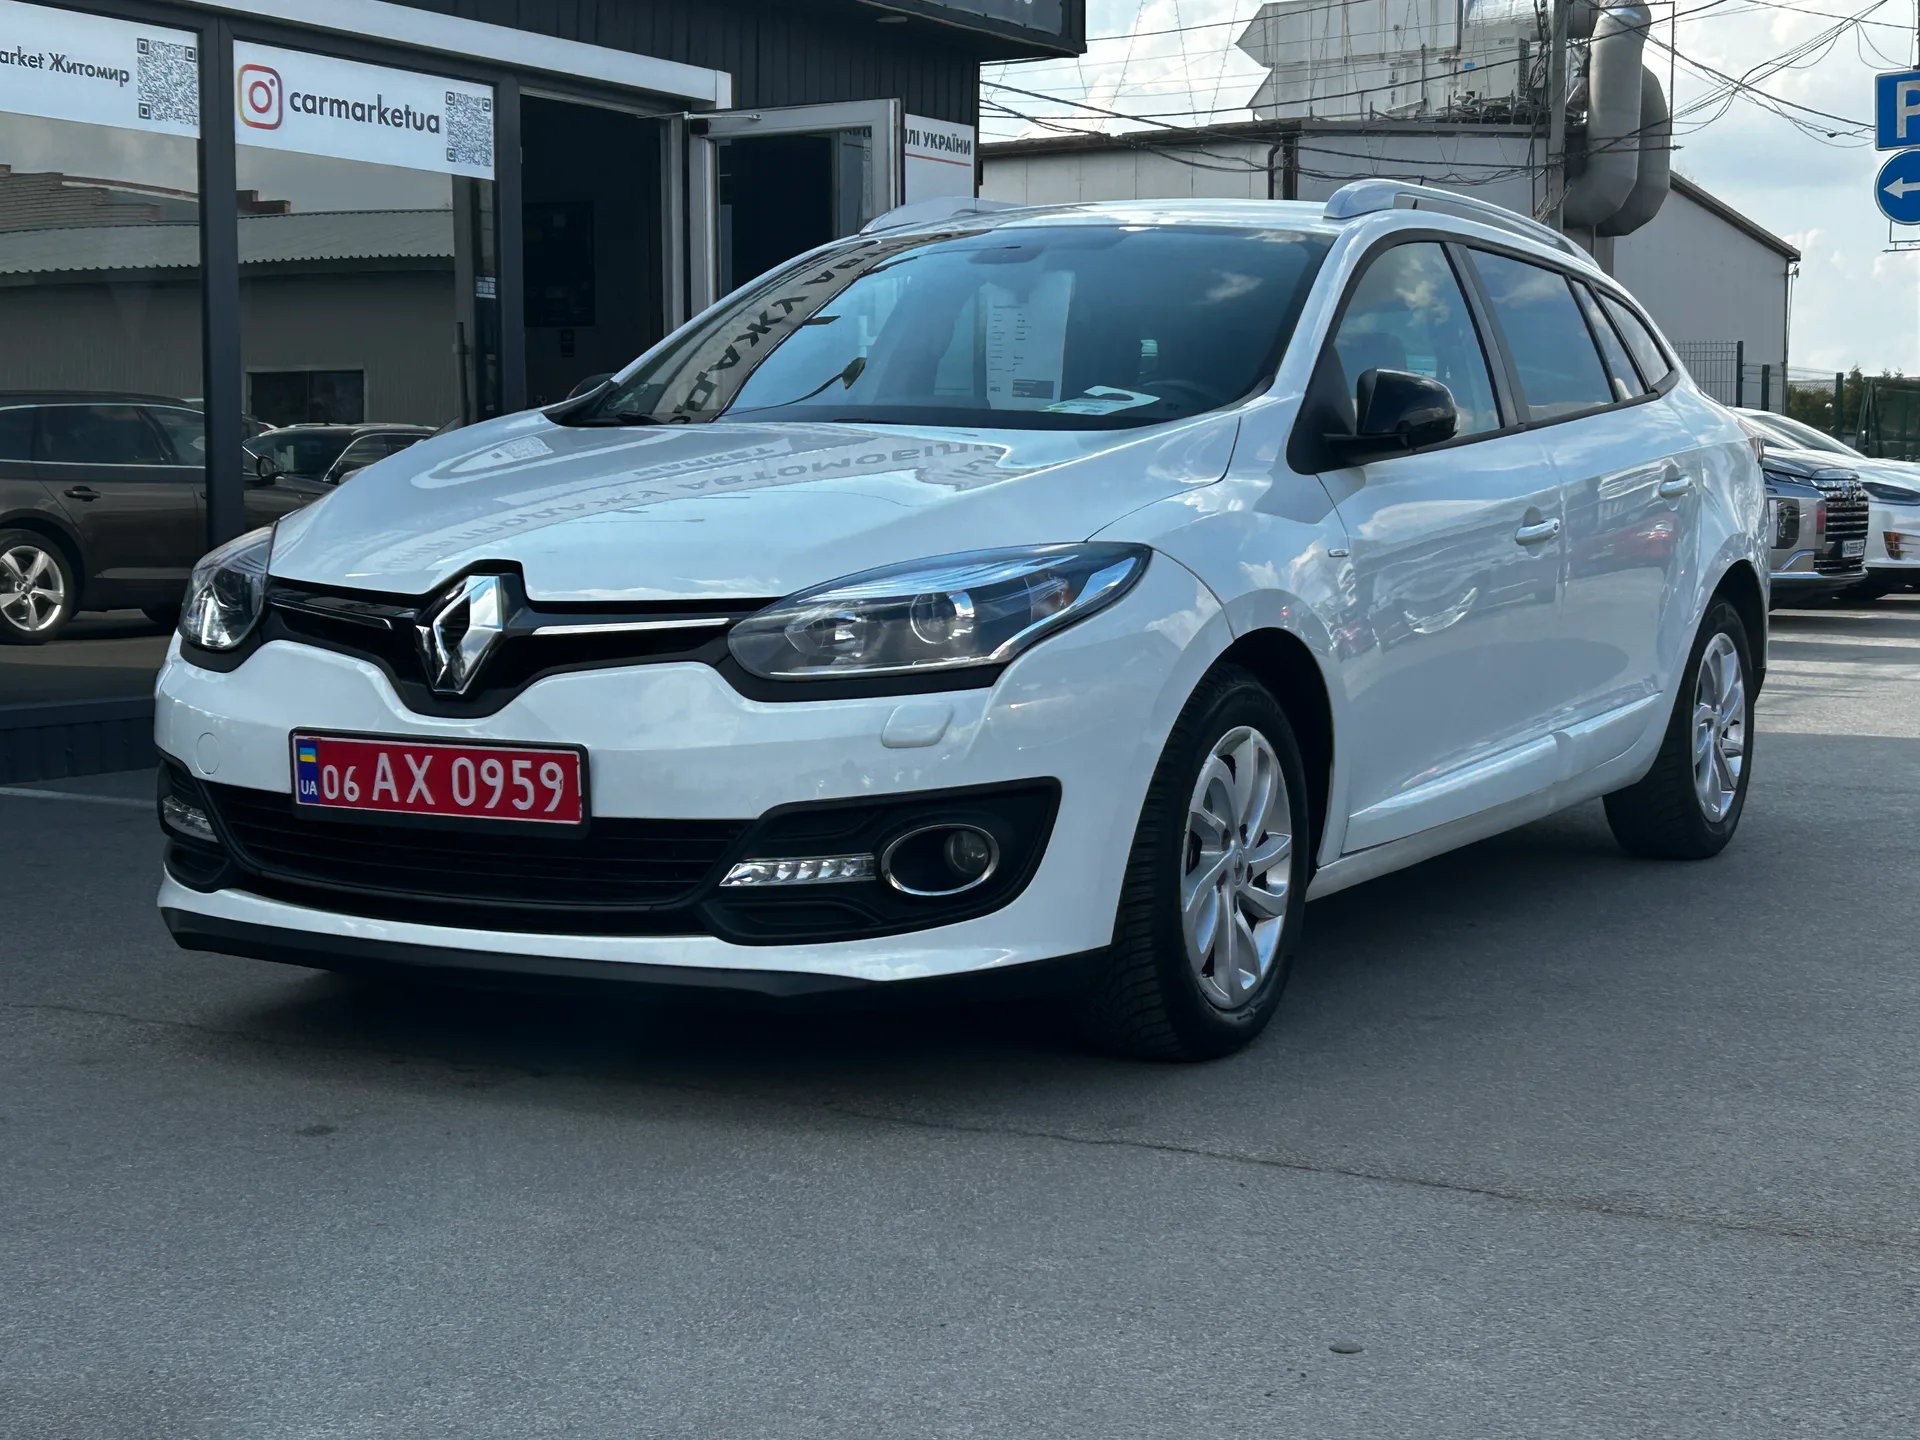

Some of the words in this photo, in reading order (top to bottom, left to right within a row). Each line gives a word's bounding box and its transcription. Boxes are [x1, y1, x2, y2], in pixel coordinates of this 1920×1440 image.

[48, 52, 130, 87] Житомир
[289, 91, 440, 134] carmarketua
[1896, 79, 1920, 139] P
[923, 131, 971, 156] УКРАЇНИ
[300, 779, 318, 796] UA
[322, 764, 361, 802] 06
[371, 752, 436, 806] AX
[451, 756, 565, 813] 0959
